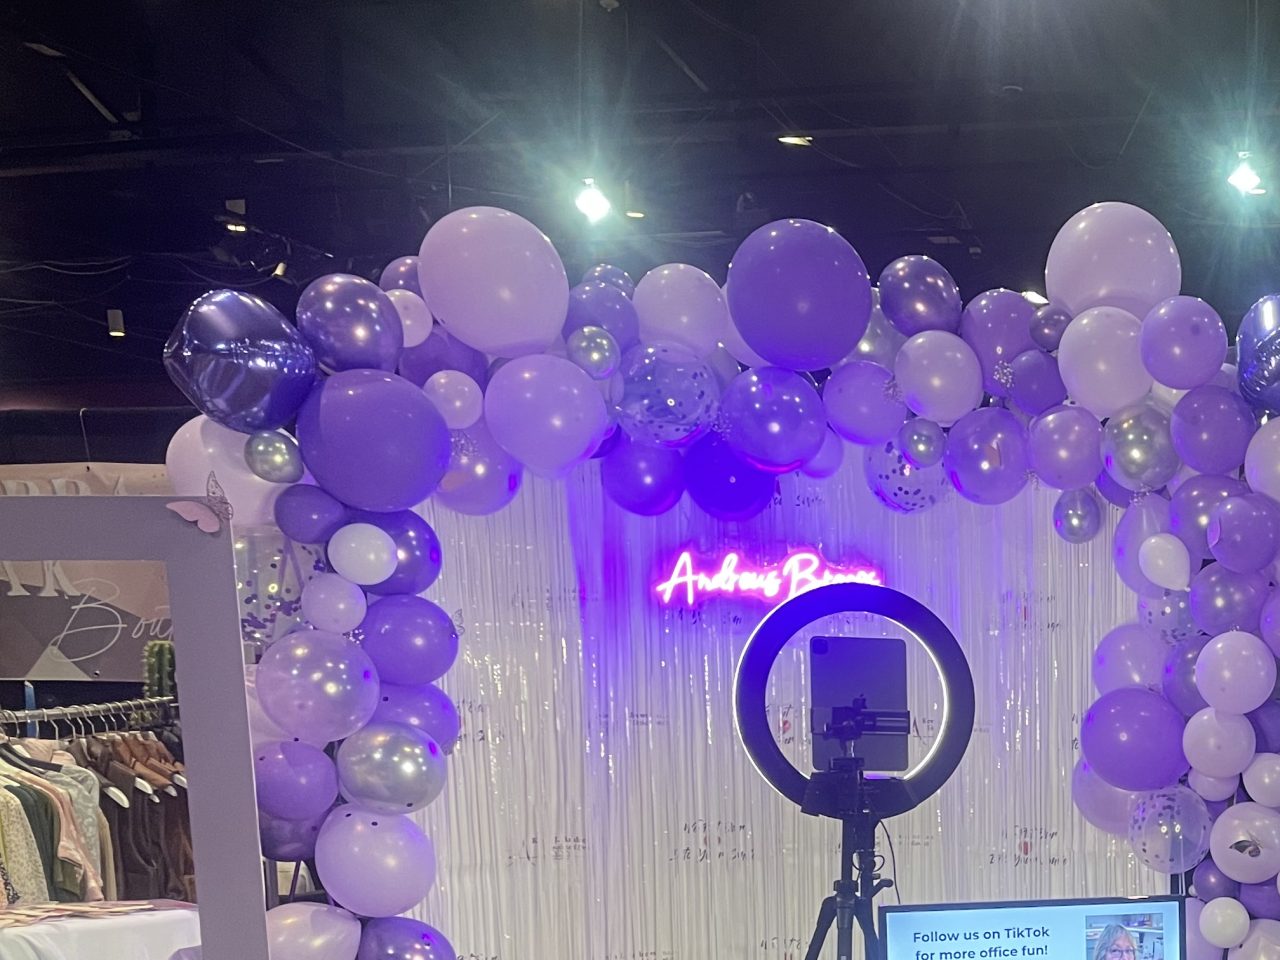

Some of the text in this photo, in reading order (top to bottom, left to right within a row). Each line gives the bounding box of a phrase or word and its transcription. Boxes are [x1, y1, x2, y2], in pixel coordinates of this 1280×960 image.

[656, 551, 782, 605] Andrews
[913, 926, 1050, 943] Follow us on TikTok
[939, 949, 976, 960] more
[979, 946, 1018, 958] office
[1021, 944, 1048, 956] fun!
